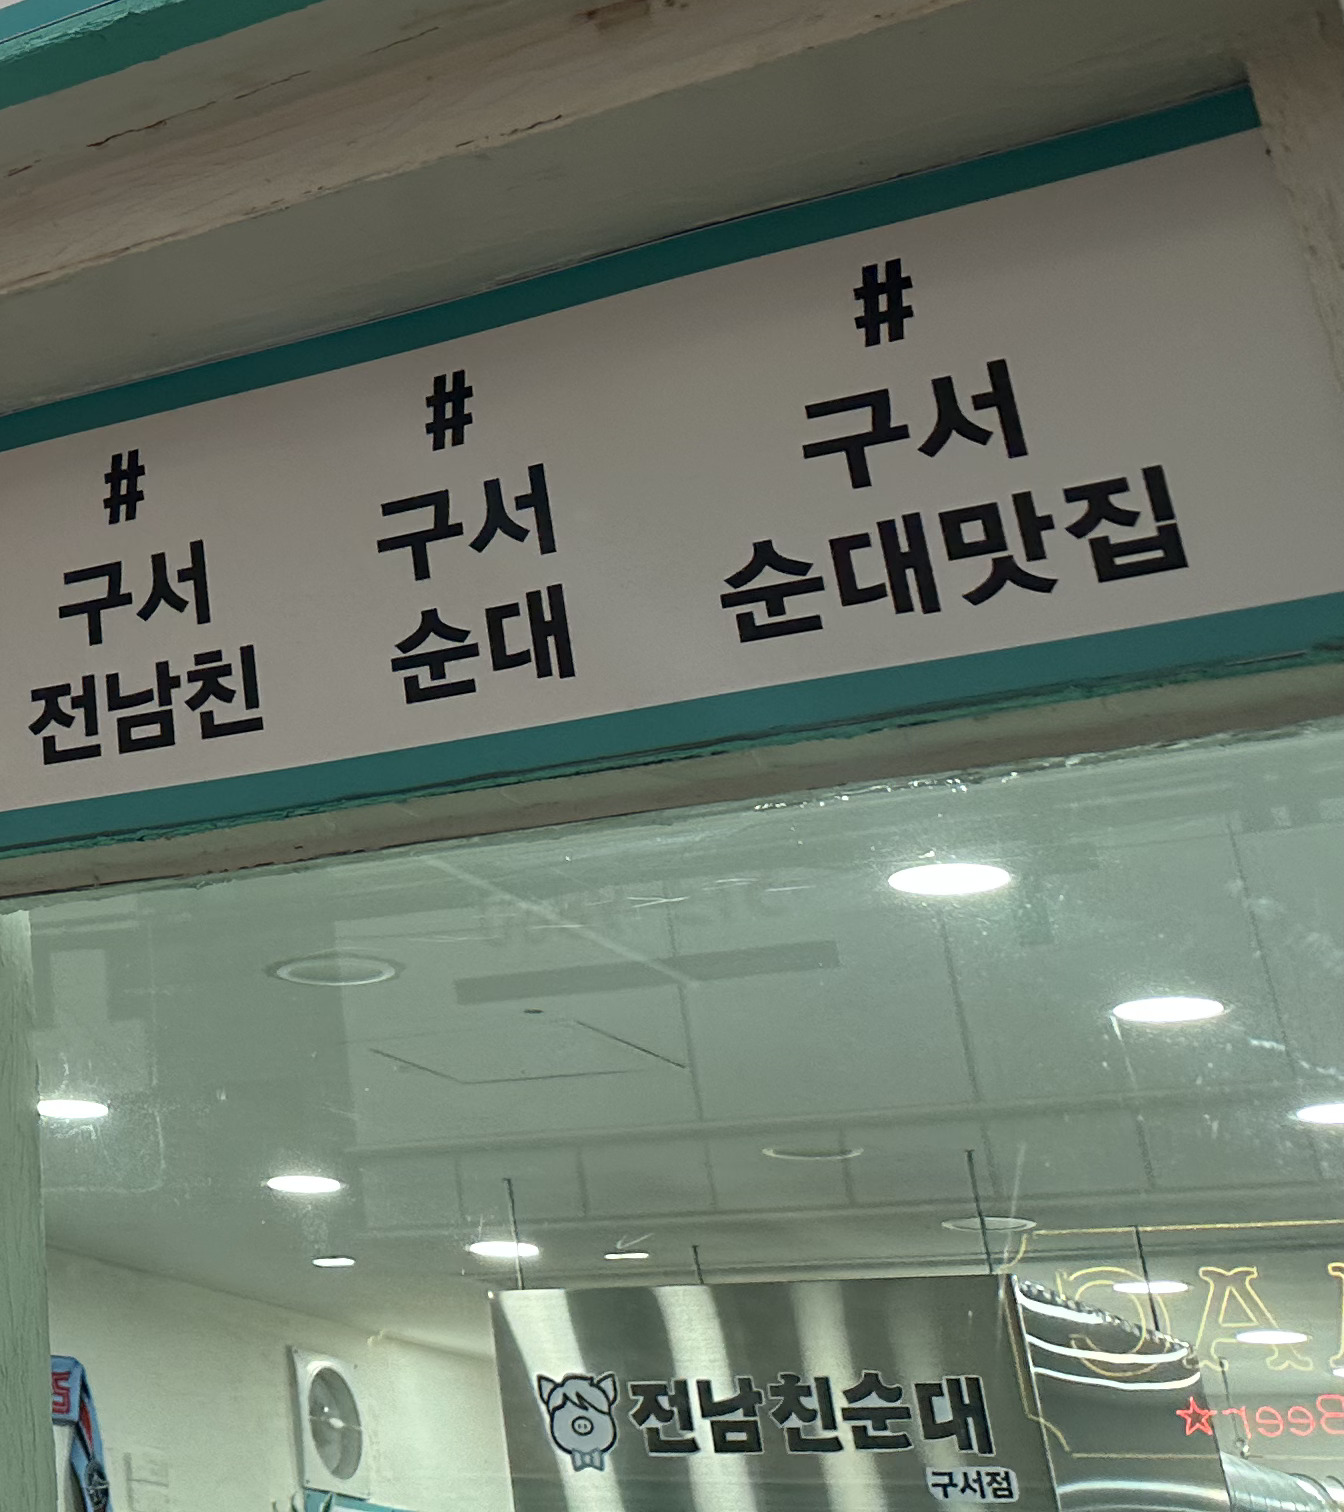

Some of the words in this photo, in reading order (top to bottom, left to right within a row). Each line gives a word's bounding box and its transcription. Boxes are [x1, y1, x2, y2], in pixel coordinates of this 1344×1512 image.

[800, 358, 1030, 490] 구서
[376, 463, 558, 583] 구서
[718, 464, 1189, 644] 순대맛집
[57, 539, 213, 646] 구서
[391, 582, 576, 705] 순대
[28, 644, 265, 767] 전남친
[628, 1371, 995, 1455] 전남친순대
[930, 1469, 1013, 1500] 구서점
